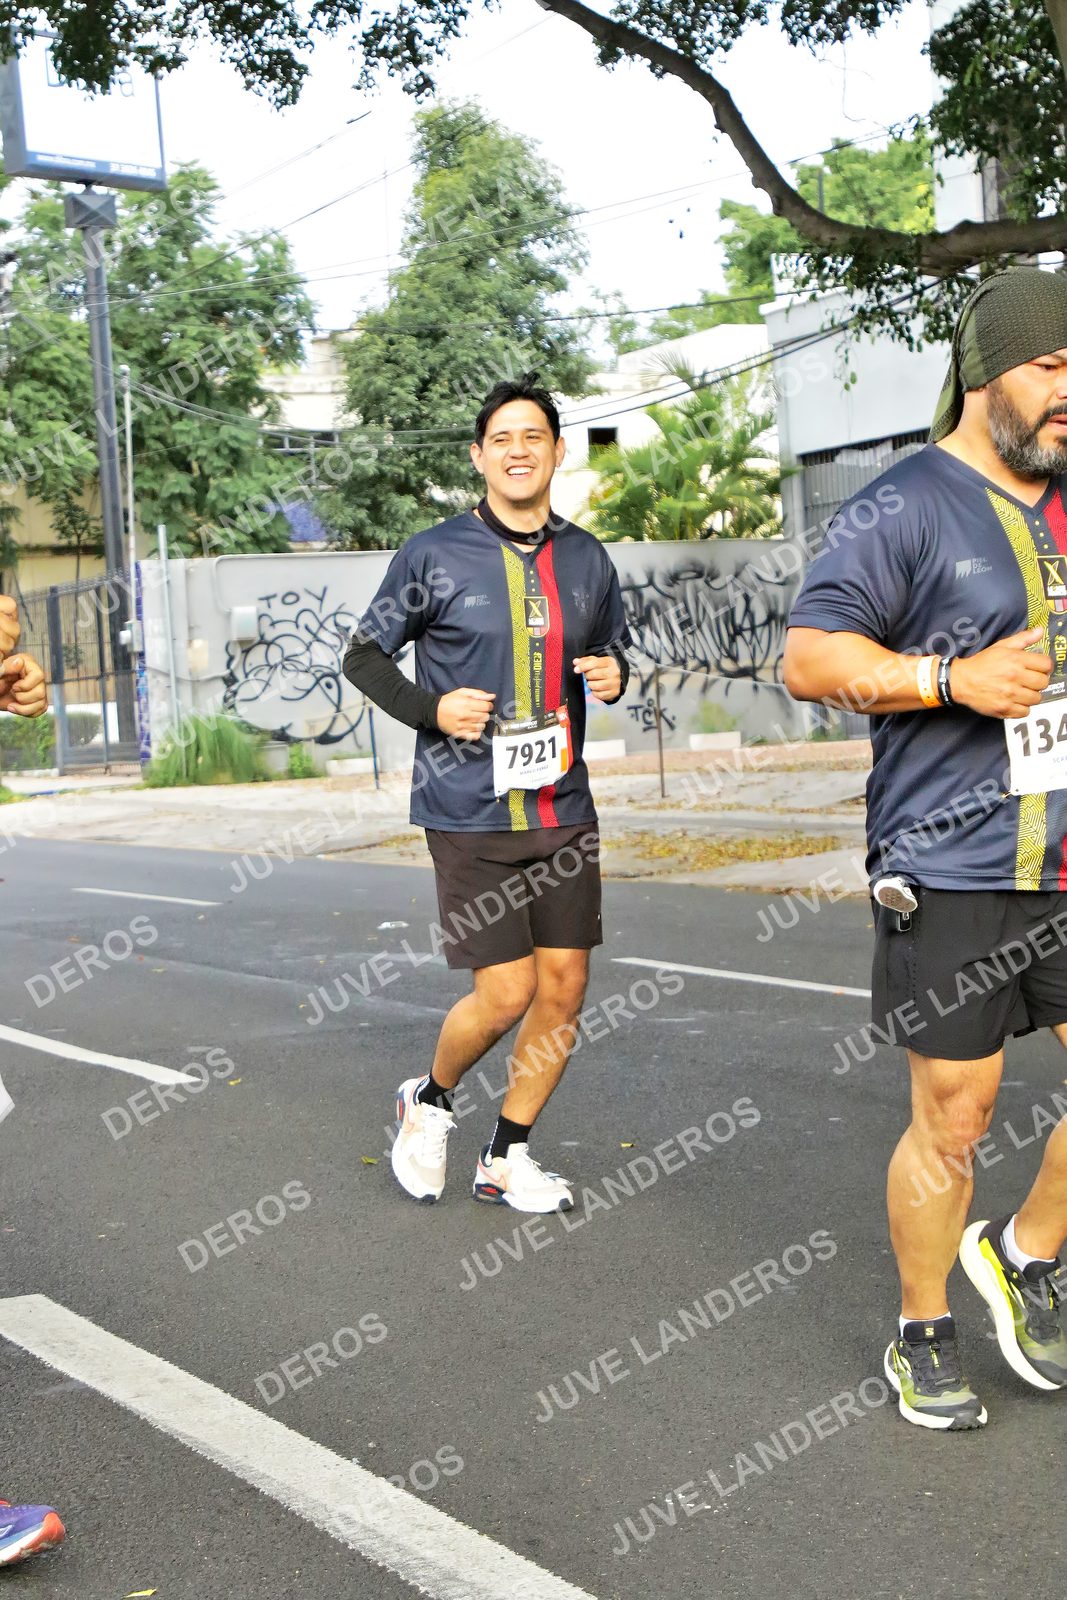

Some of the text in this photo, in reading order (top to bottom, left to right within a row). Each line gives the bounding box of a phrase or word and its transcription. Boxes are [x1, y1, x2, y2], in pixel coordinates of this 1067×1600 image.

[258, 585, 328, 613] TOY
[505, 735, 558, 769] 7921
[925, 1327, 935, 1337] S
